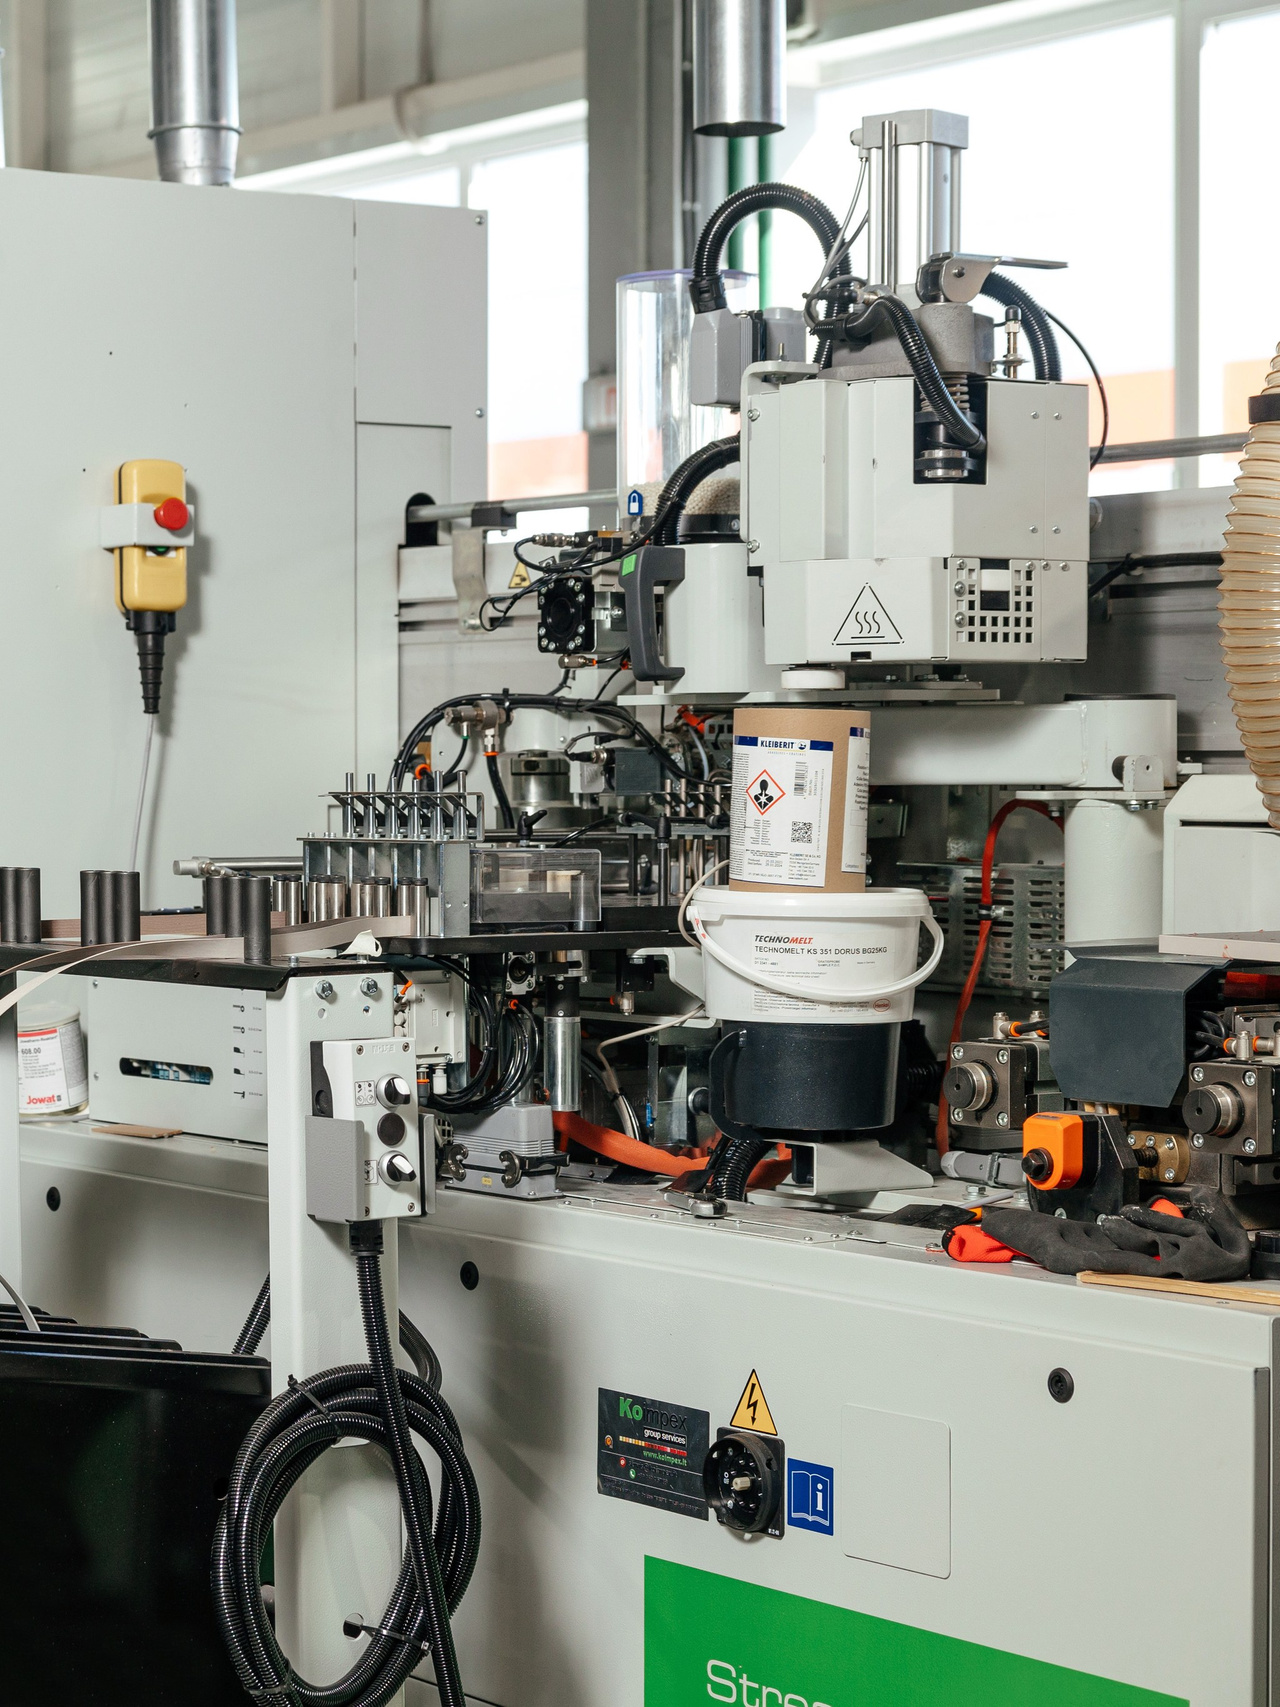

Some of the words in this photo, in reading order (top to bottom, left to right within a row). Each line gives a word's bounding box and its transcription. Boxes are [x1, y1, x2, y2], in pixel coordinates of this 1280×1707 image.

[760, 740, 795, 749] KLEIBERIT
[755, 946, 804, 955] TECHNOMELT
[807, 947, 818, 955] KS
[862, 946, 888, 954] BG25KG
[21, 1047, 42, 1055] 608.00
[26, 1094, 56, 1105] Jowat
[619, 1397, 687, 1431] Koimpex
[644, 1428, 662, 1440] group
[662, 1433, 686, 1445] services
